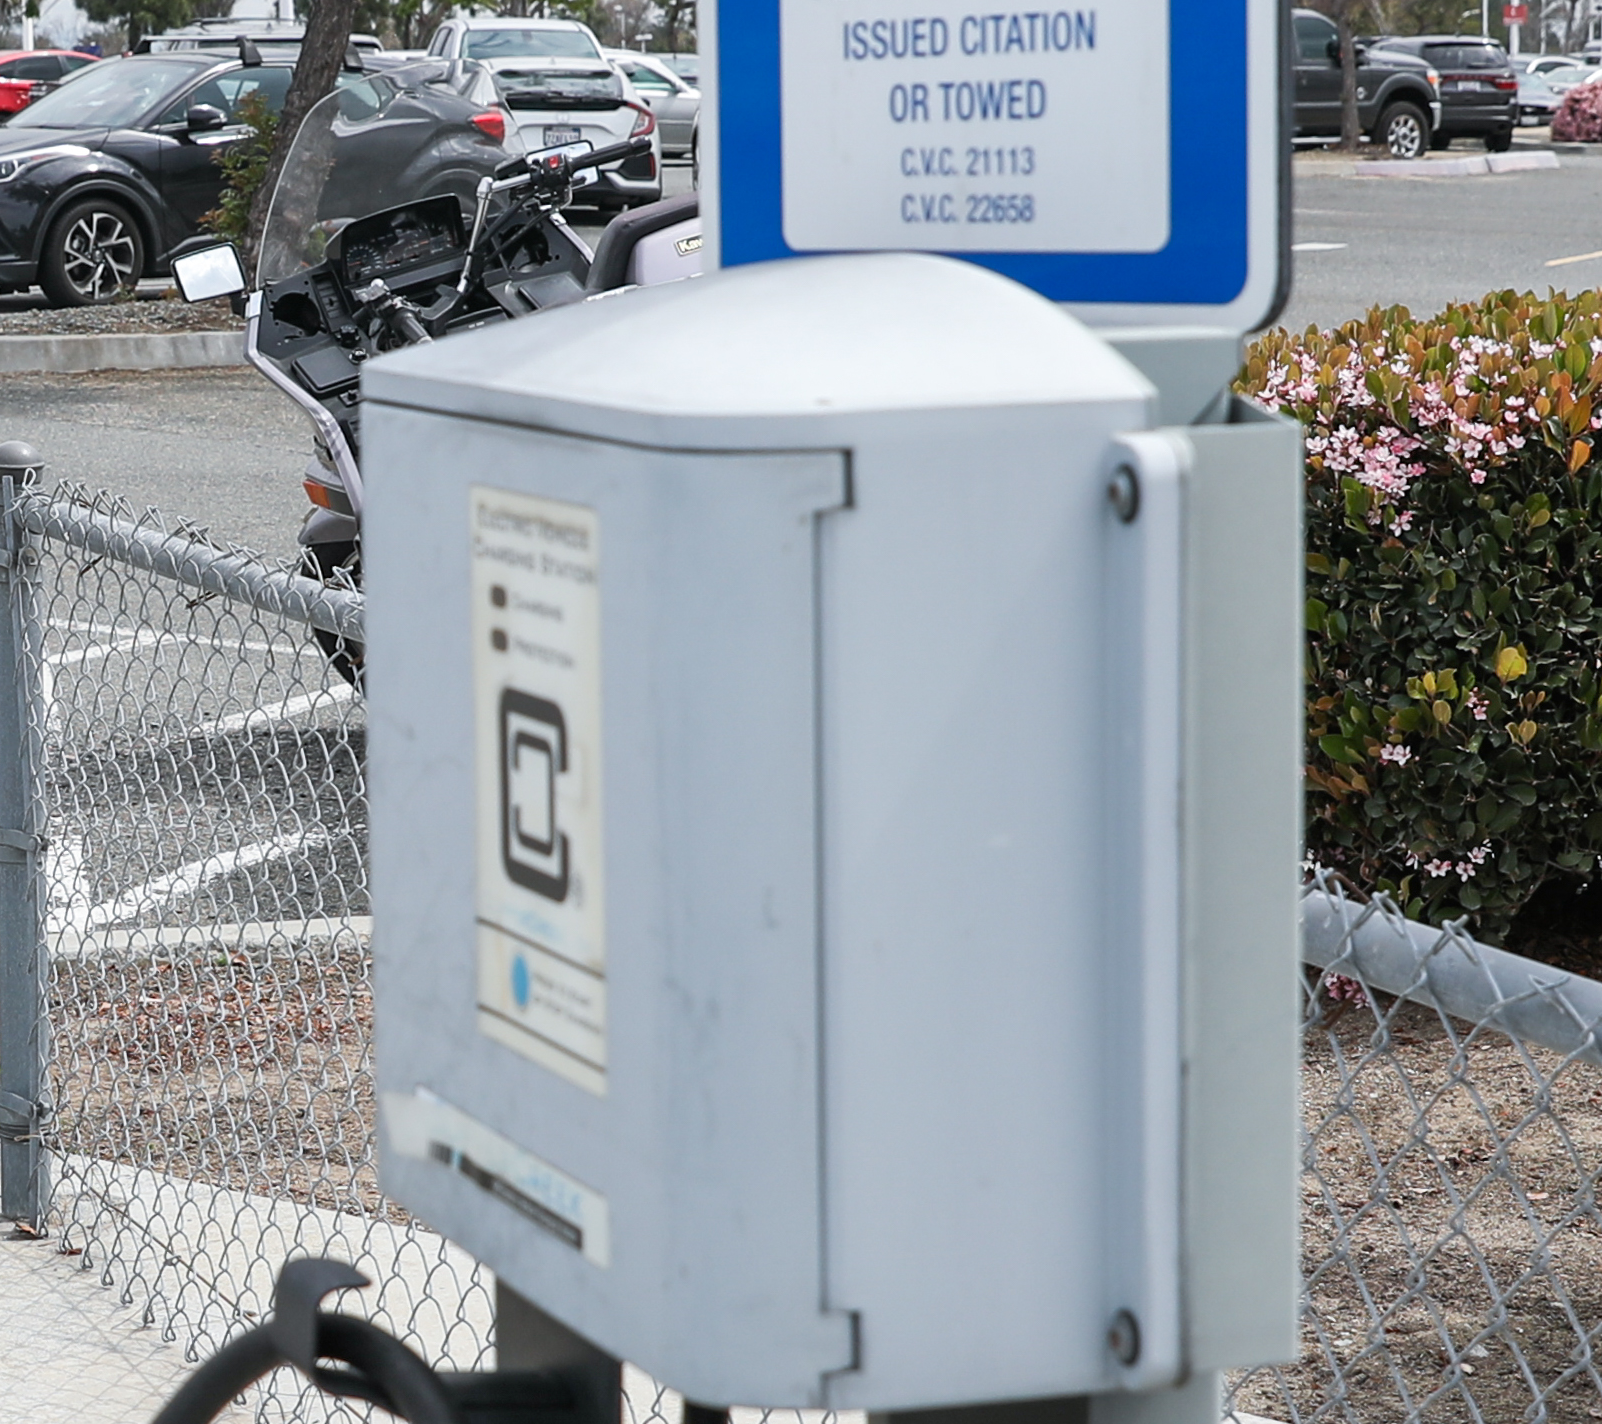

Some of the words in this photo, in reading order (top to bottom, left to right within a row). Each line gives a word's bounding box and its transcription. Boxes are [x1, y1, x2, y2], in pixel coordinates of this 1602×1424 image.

[843, 17, 949, 61] ISSUED
[960, 10, 1096, 57] CITATION
[889, 82, 930, 124] OR
[937, 79, 1047, 122] TOWED
[900, 146, 959, 178] C.V.C.
[965, 146, 1036, 178] 21113
[900, 193, 960, 225] C.V.C.
[965, 193, 1036, 225] 22658
